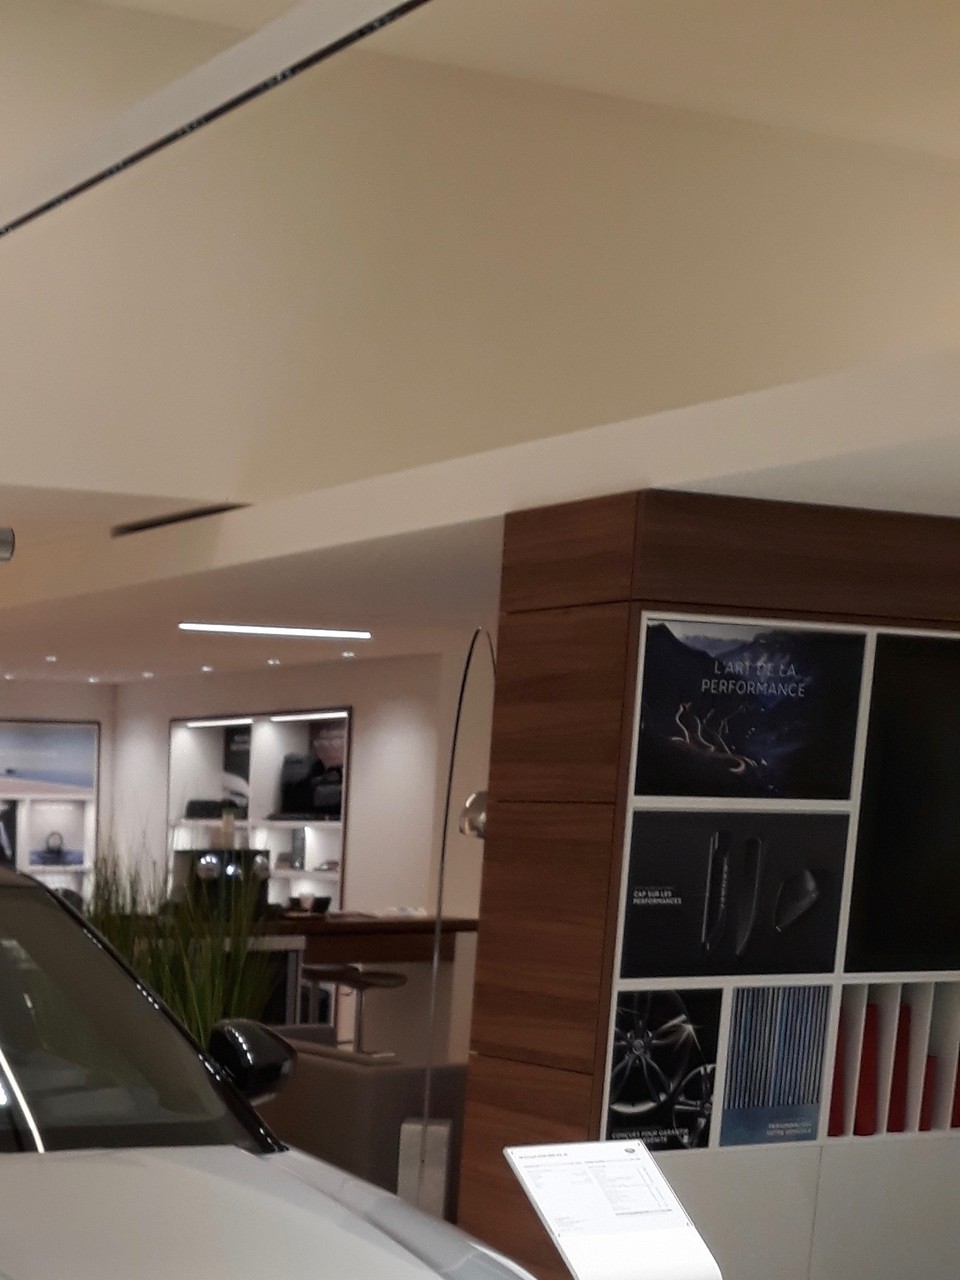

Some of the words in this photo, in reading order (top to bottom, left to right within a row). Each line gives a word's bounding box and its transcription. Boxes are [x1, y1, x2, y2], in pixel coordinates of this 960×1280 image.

[714, 659, 751, 676] L'ART
[779, 662, 798, 678] LA
[700, 678, 806, 698] PERFORMANCE
